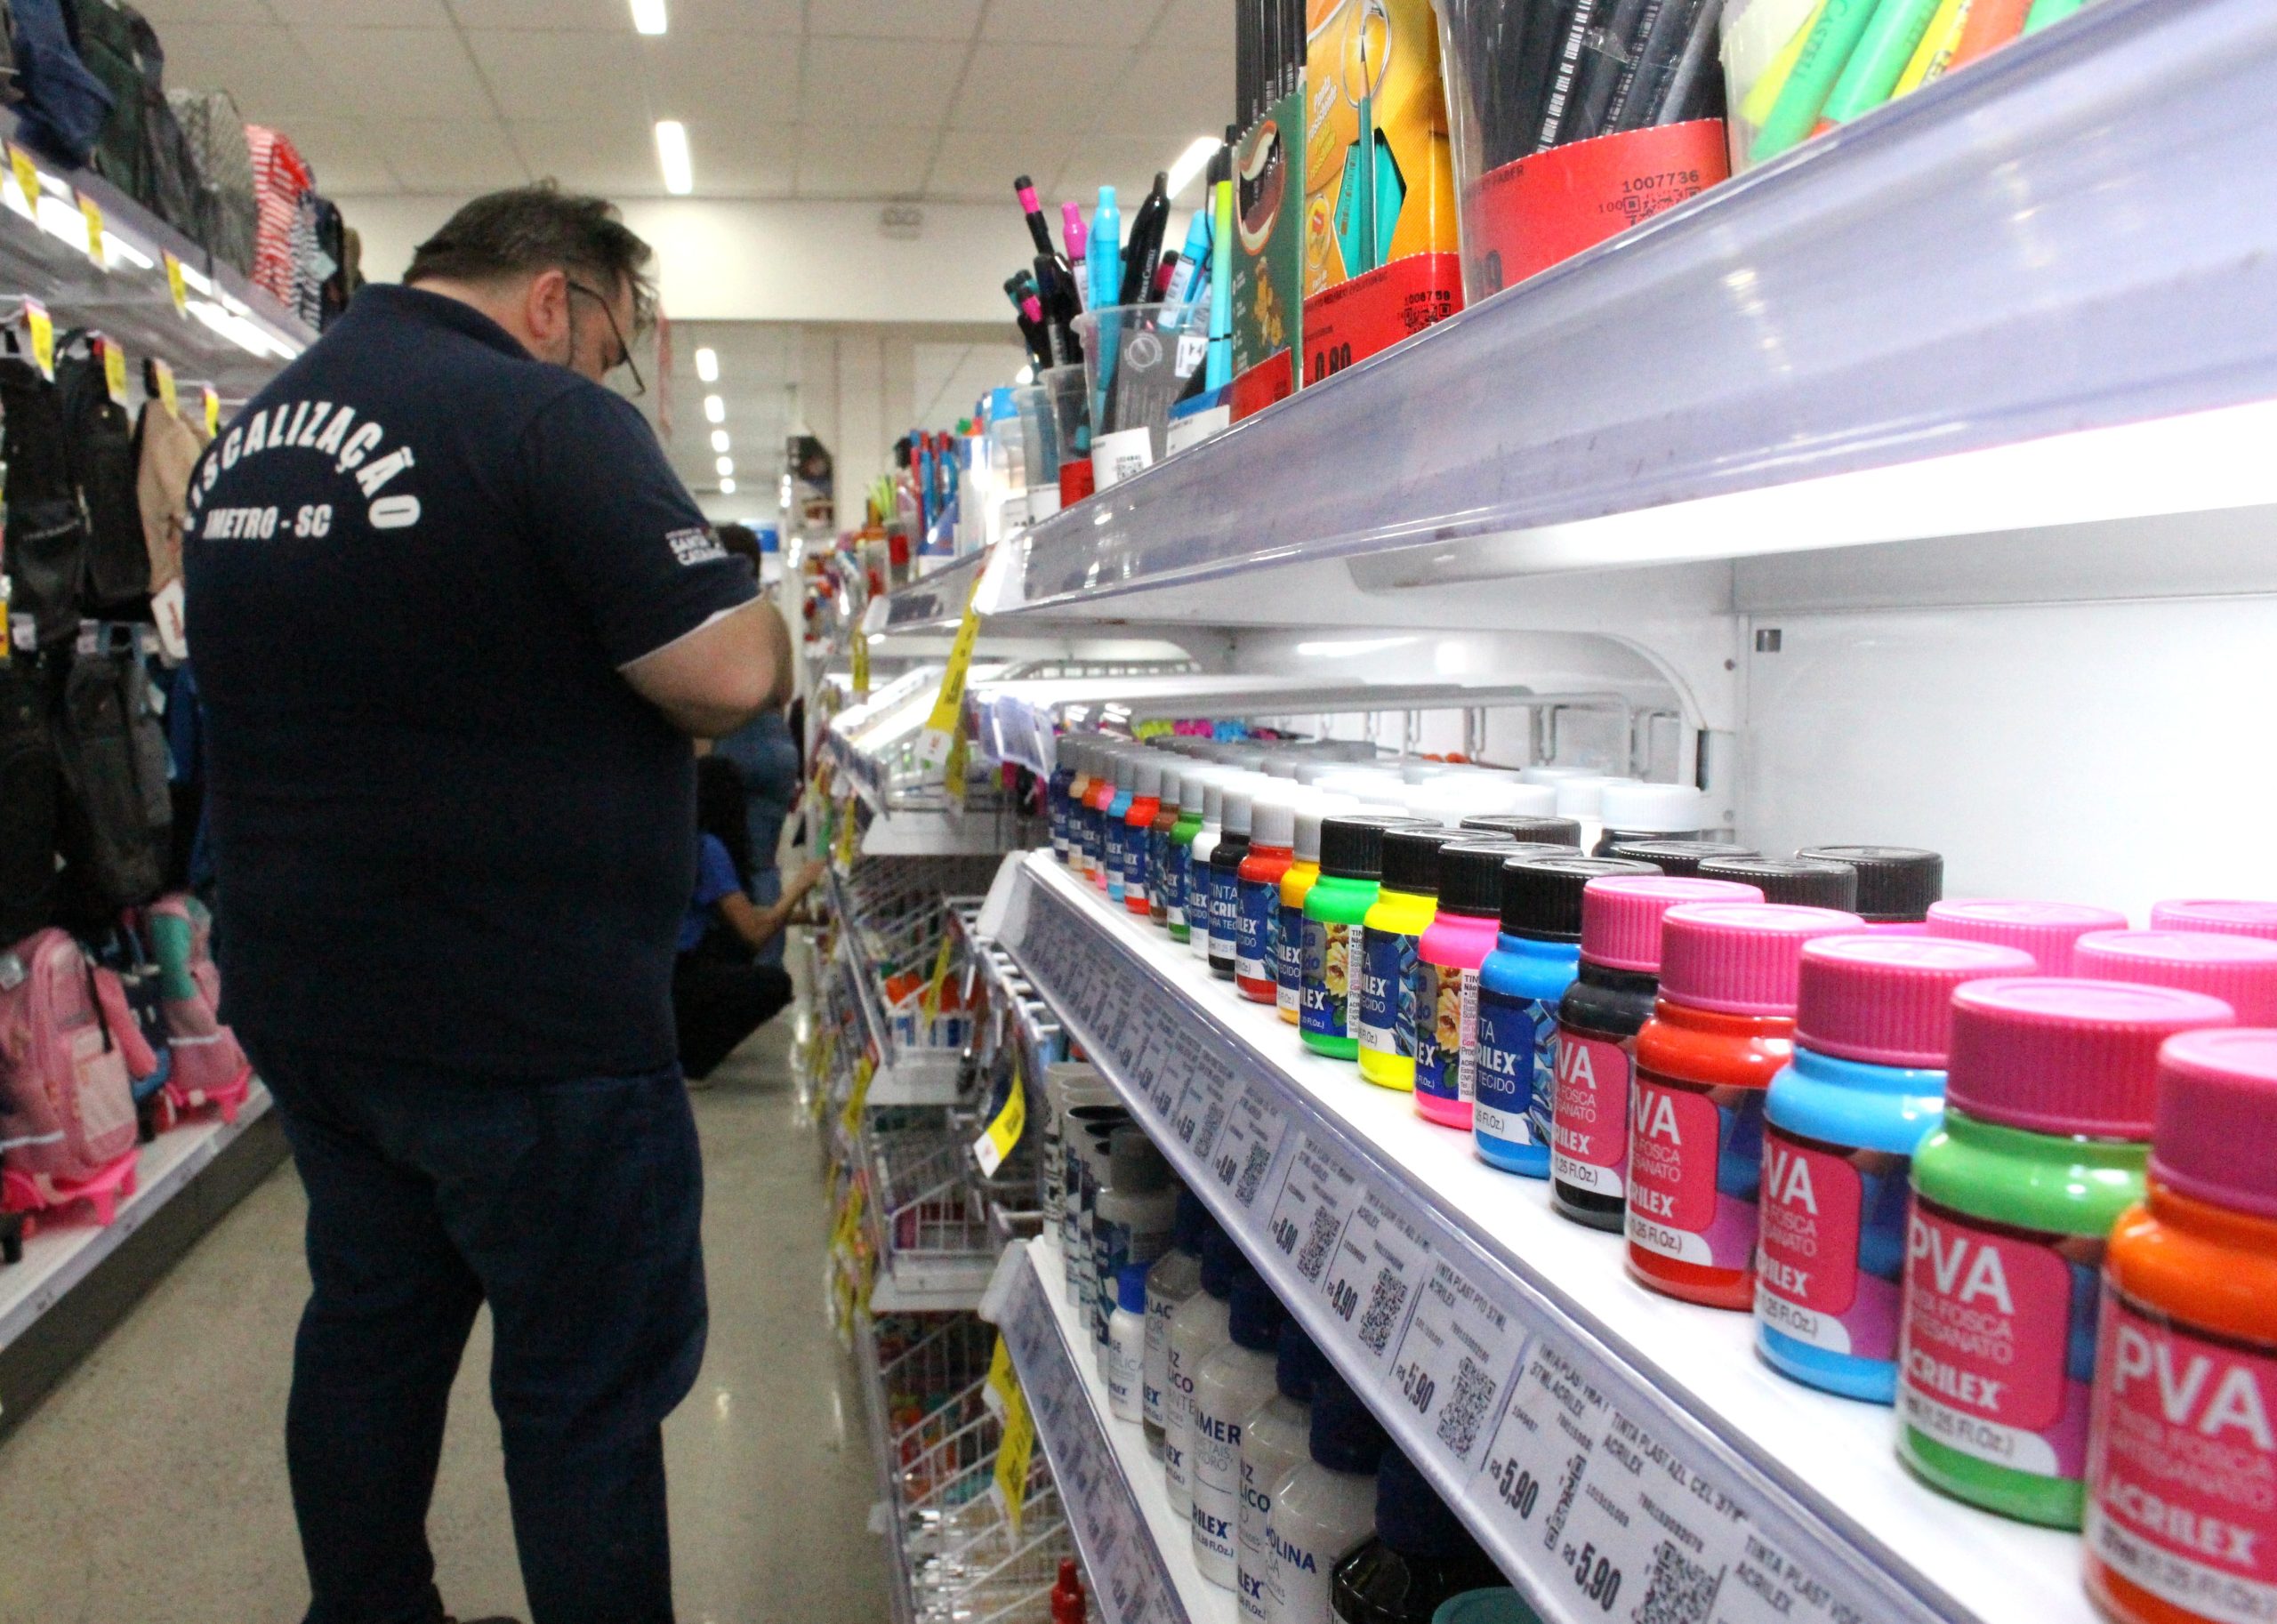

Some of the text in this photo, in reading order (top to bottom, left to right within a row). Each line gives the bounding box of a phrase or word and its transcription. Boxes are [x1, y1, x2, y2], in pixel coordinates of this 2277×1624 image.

[1623, 170, 1699, 193] 1007736
[294, 503, 333, 538] SC
[1476, 1041, 1517, 1077] RILEX
[1557, 1037, 1597, 1090] VA
[1556, 1122, 1590, 1155] RILEX
[1634, 1083, 1682, 1146] VA
[1761, 1139, 1819, 1216] VA
[1911, 1213, 2016, 1315] PVA
[1404, 1362, 1435, 1414] 5,90
[1911, 1345, 2008, 1412] CRILEX
[2111, 1323, 2277, 1453] PVA
[1499, 1457, 1540, 1520] 5,90
[1193, 1501, 1228, 1540] RILEX
[1574, 1540, 1622, 1612] 5,90
